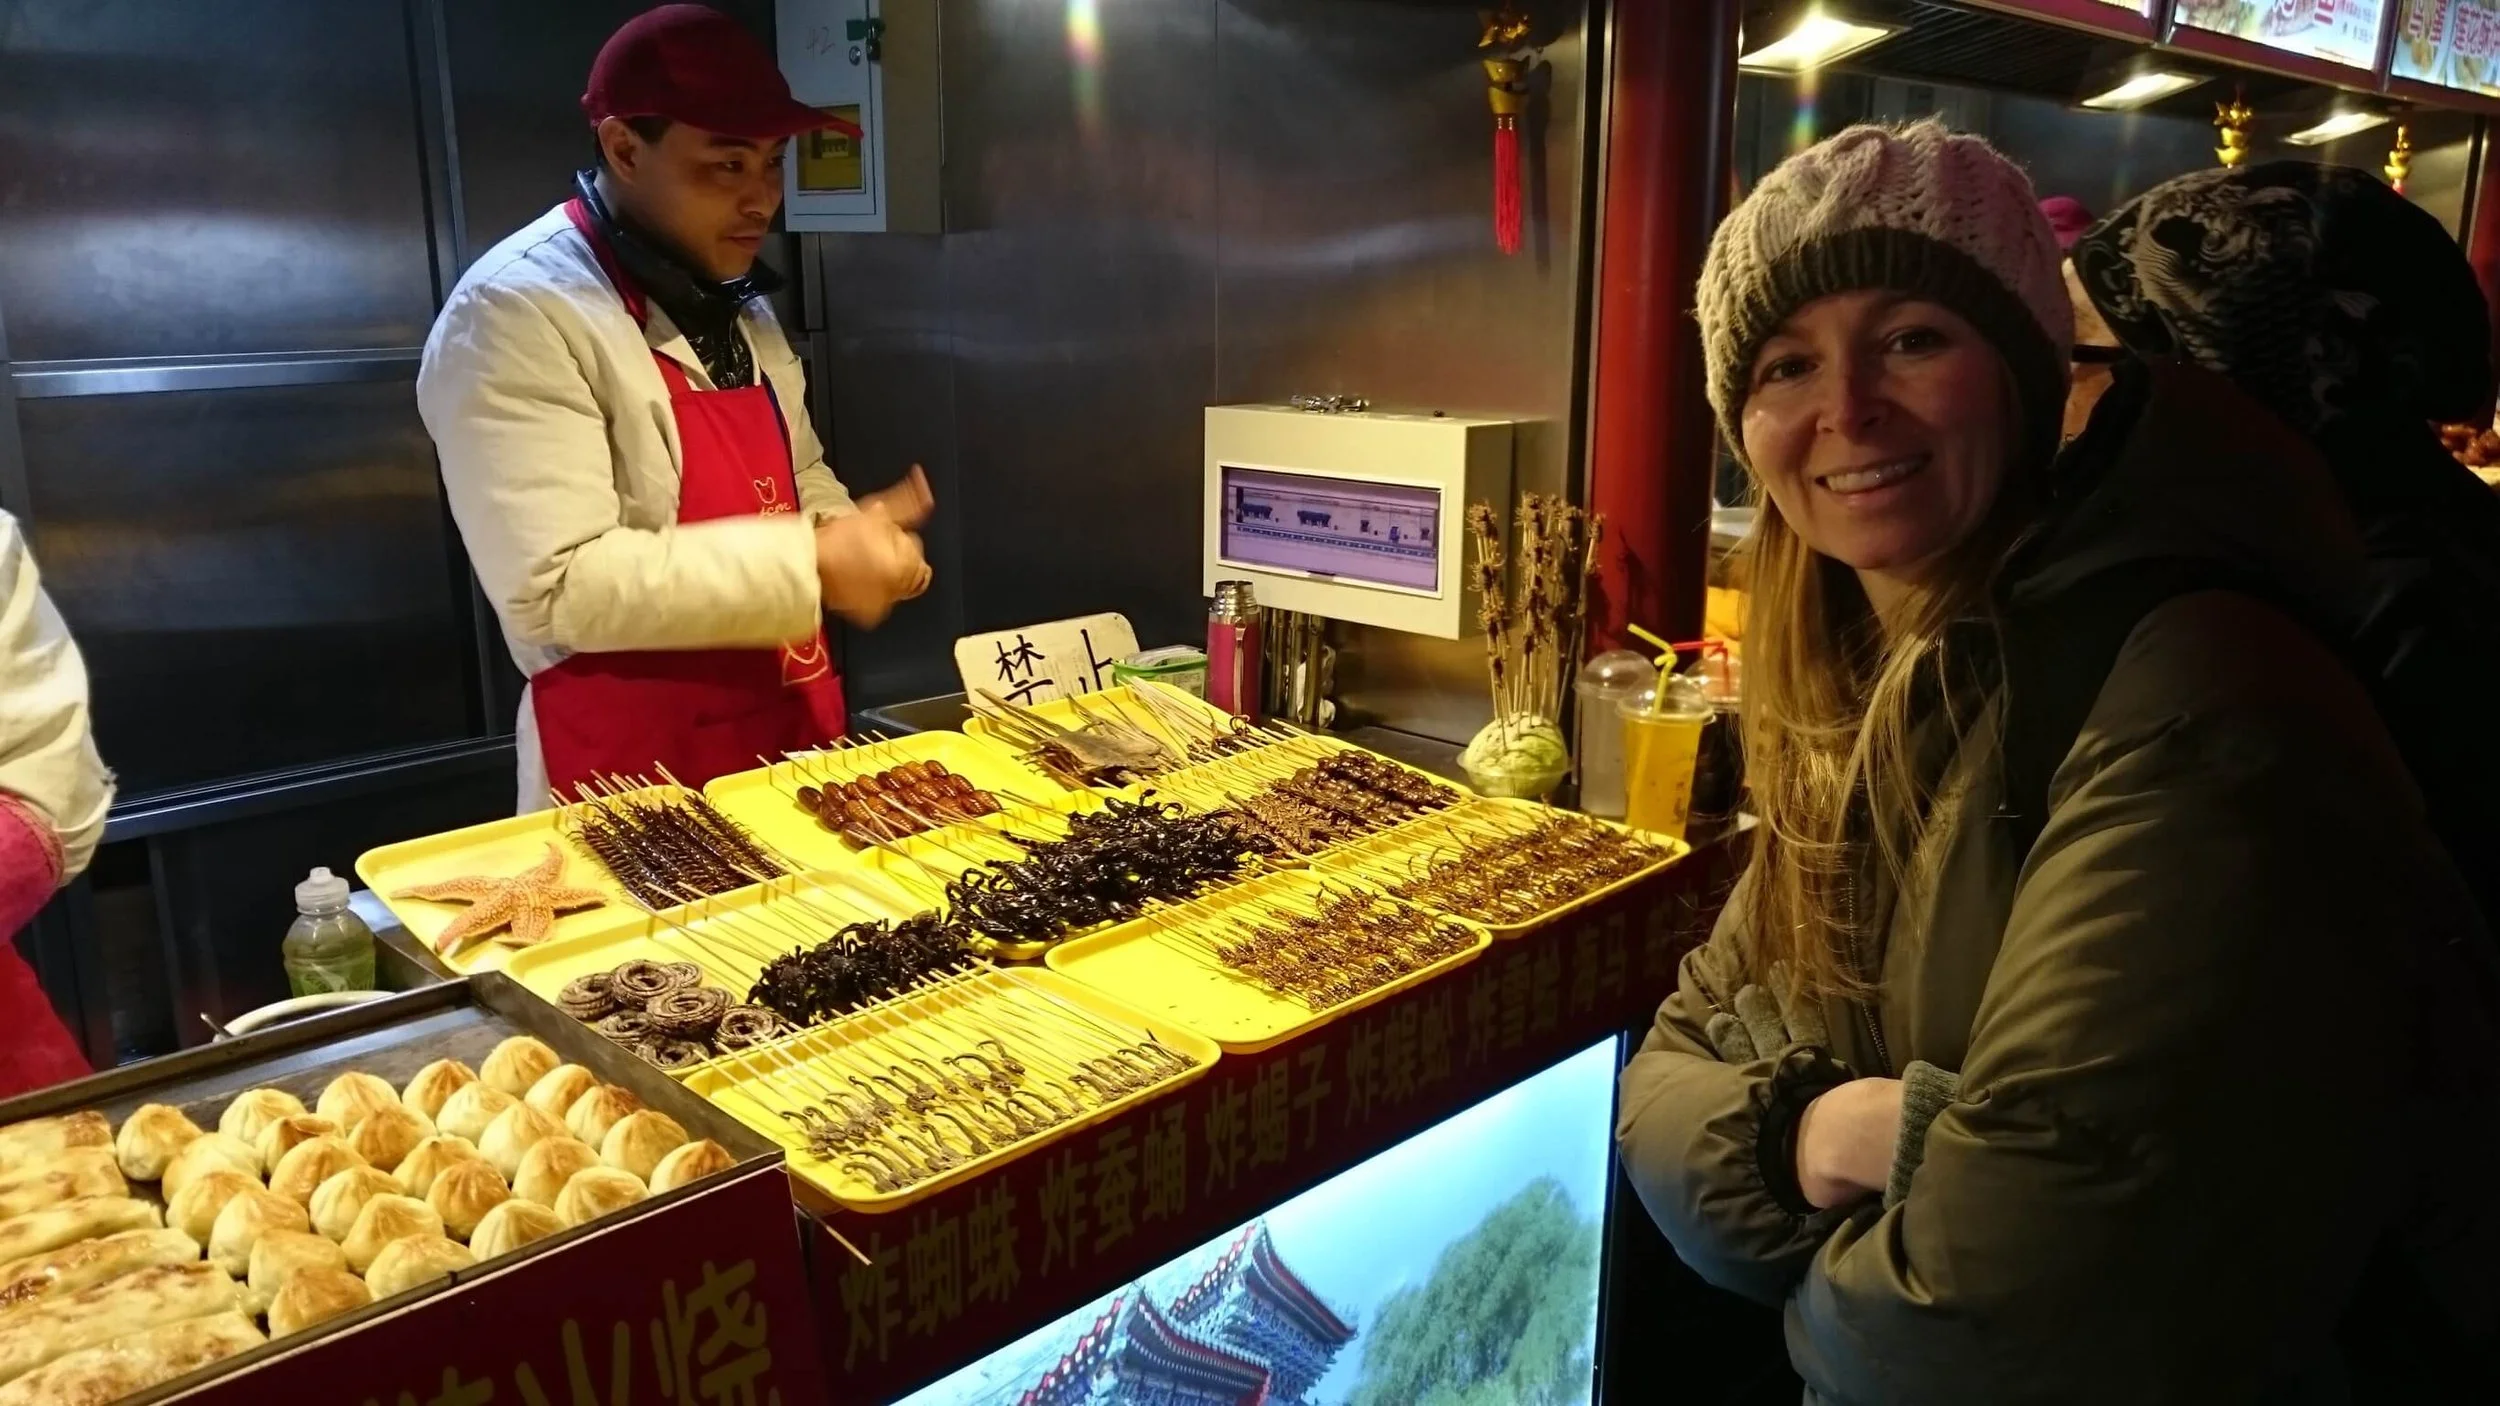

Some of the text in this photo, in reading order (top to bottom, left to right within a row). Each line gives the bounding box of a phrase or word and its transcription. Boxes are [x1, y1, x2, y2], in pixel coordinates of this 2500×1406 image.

[838, 1174, 1022, 1376] 炸蜘蛛
[1037, 1101, 1188, 1279] 炸蚕蛹
[1203, 1043, 1333, 1199] 炸蝎子
